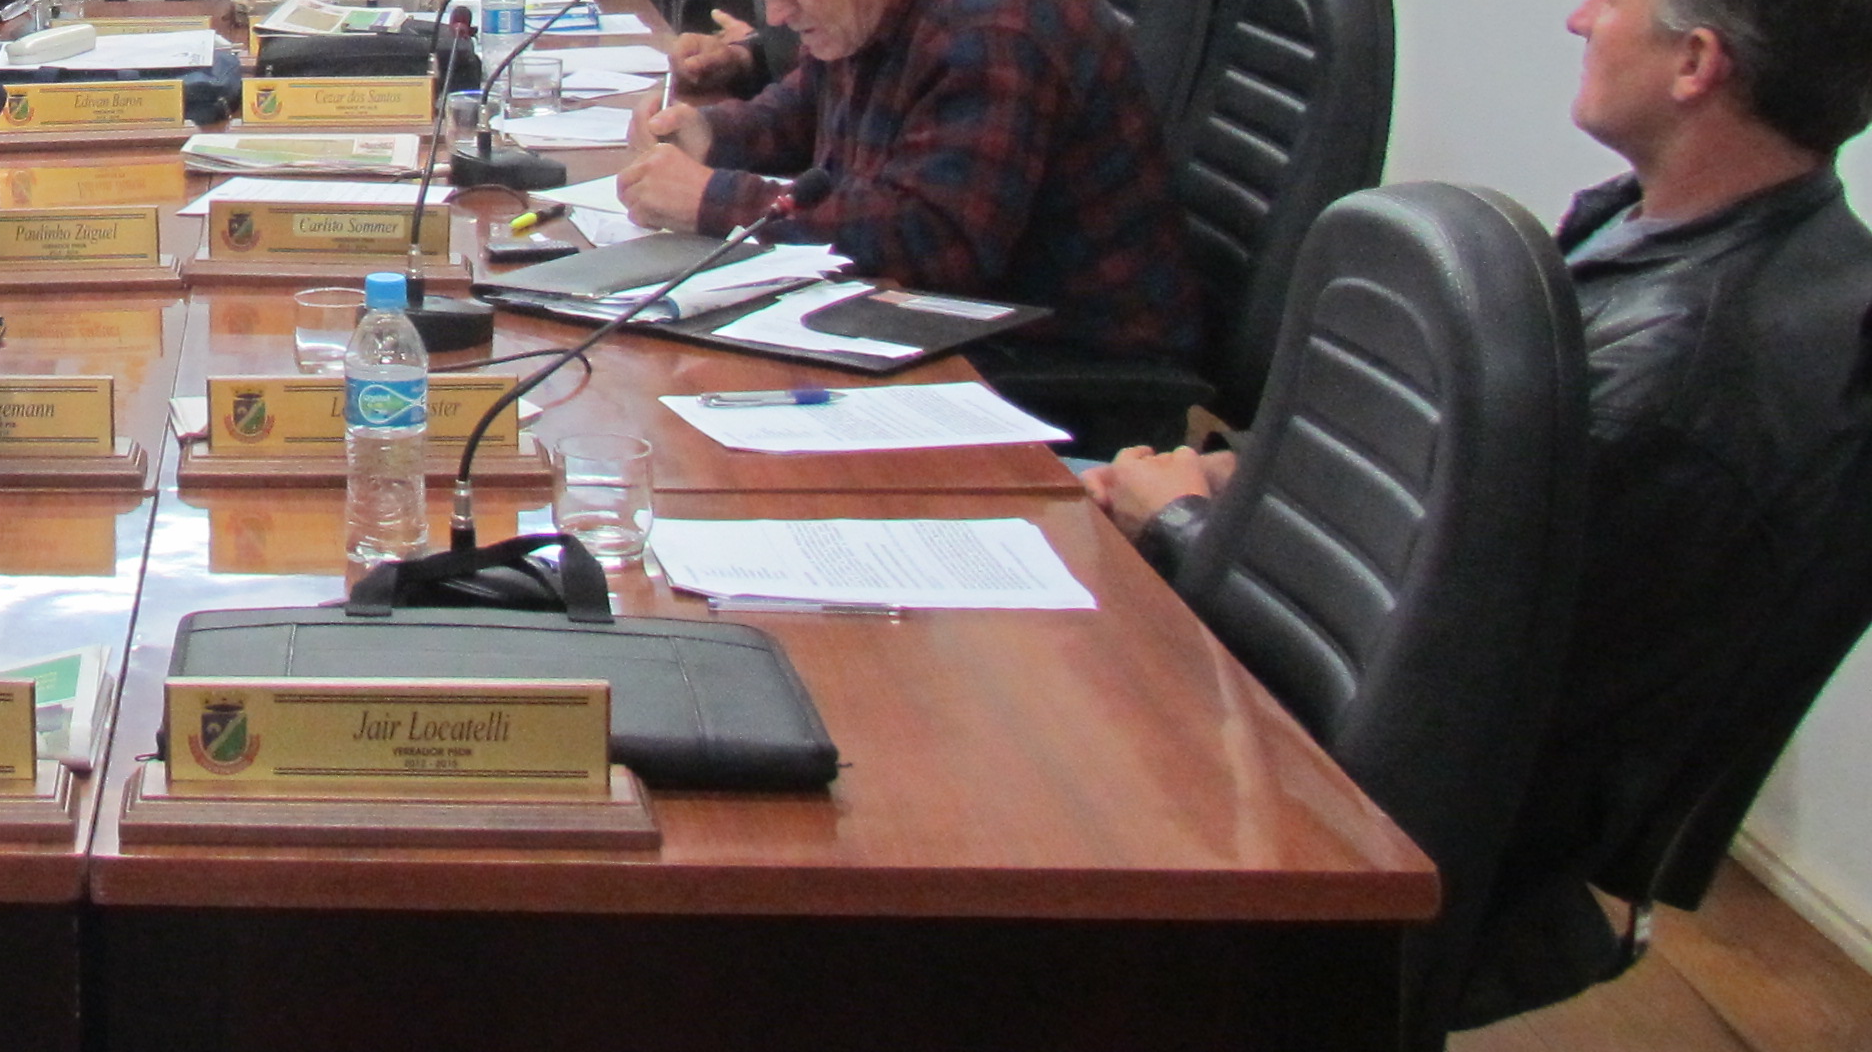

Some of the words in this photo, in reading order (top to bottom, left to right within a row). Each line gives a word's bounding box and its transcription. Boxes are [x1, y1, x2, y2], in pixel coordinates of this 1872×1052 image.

[315, 90, 345, 104] Cezar
[347, 90, 365, 103] dos
[368, 89, 401, 103] Santos
[15, 223, 71, 242] Paulinho
[299, 217, 344, 234] Carlito
[347, 217, 398, 234] Sommer
[353, 710, 402, 743] Jair
[408, 710, 511, 743] Locatelli
